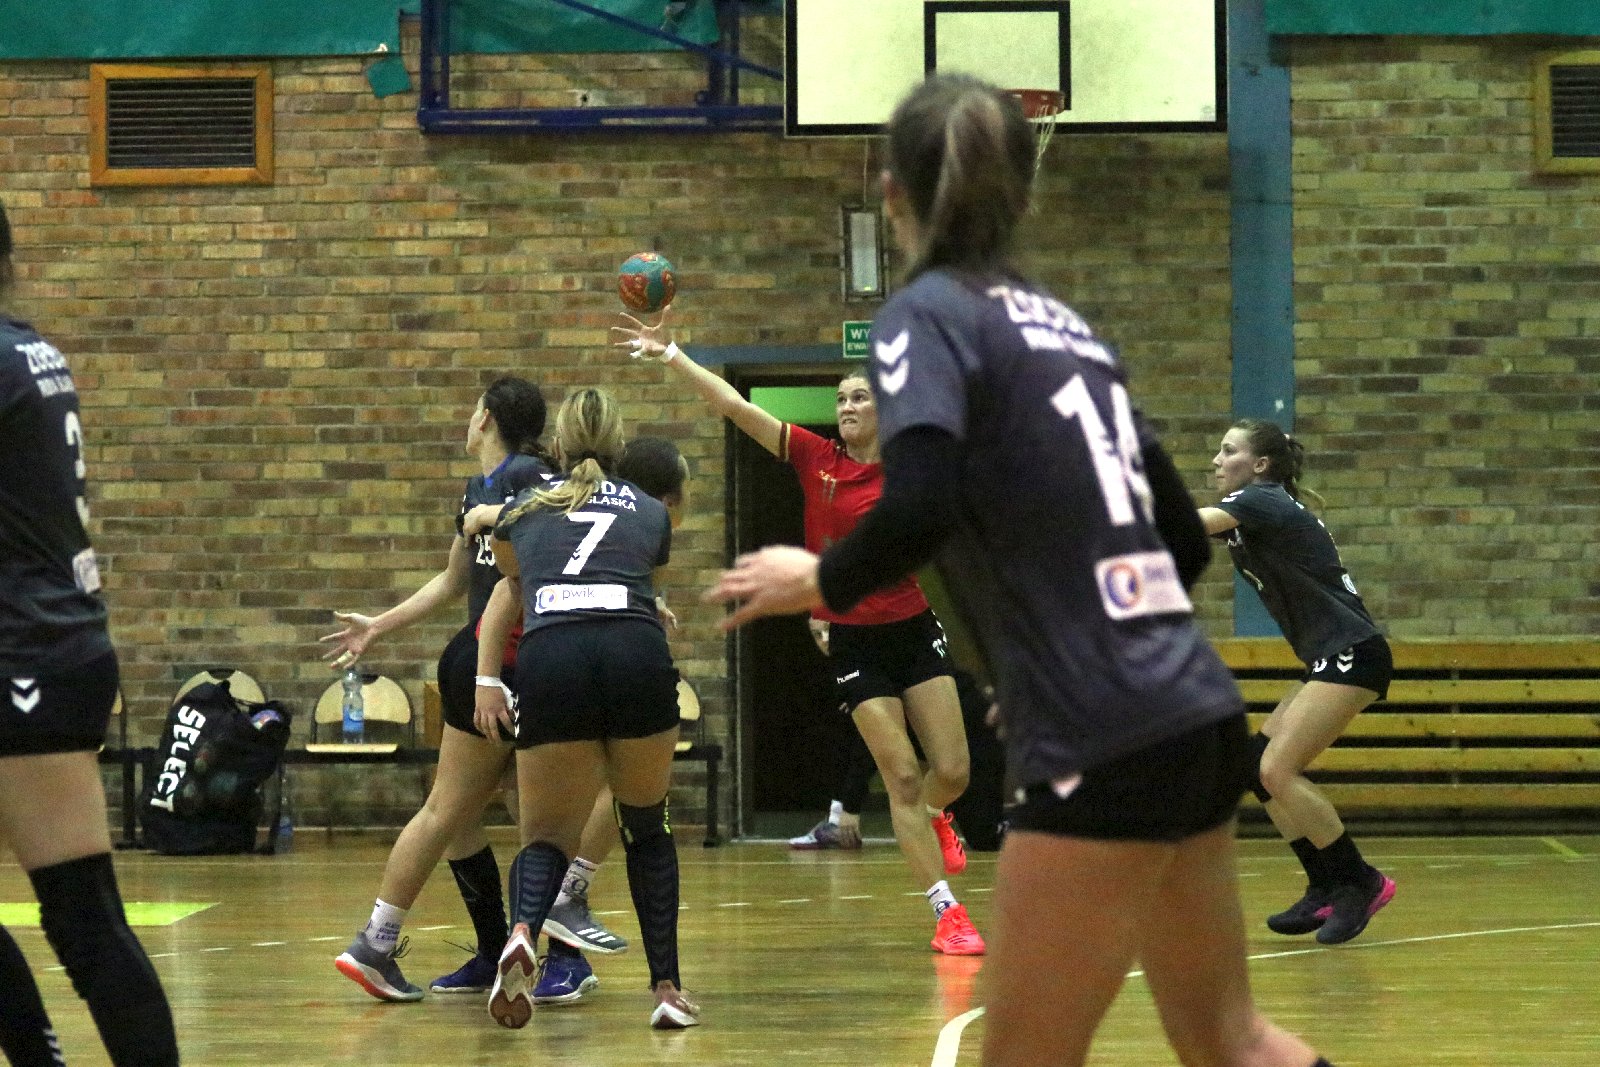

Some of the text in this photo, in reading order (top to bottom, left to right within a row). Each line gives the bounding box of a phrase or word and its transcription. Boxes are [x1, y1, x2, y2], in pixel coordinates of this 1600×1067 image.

[475, 533, 497, 567] 25
[561, 511, 618, 576] 7
[562, 587, 595, 601] pwik
[150, 704, 207, 813] SELECT
